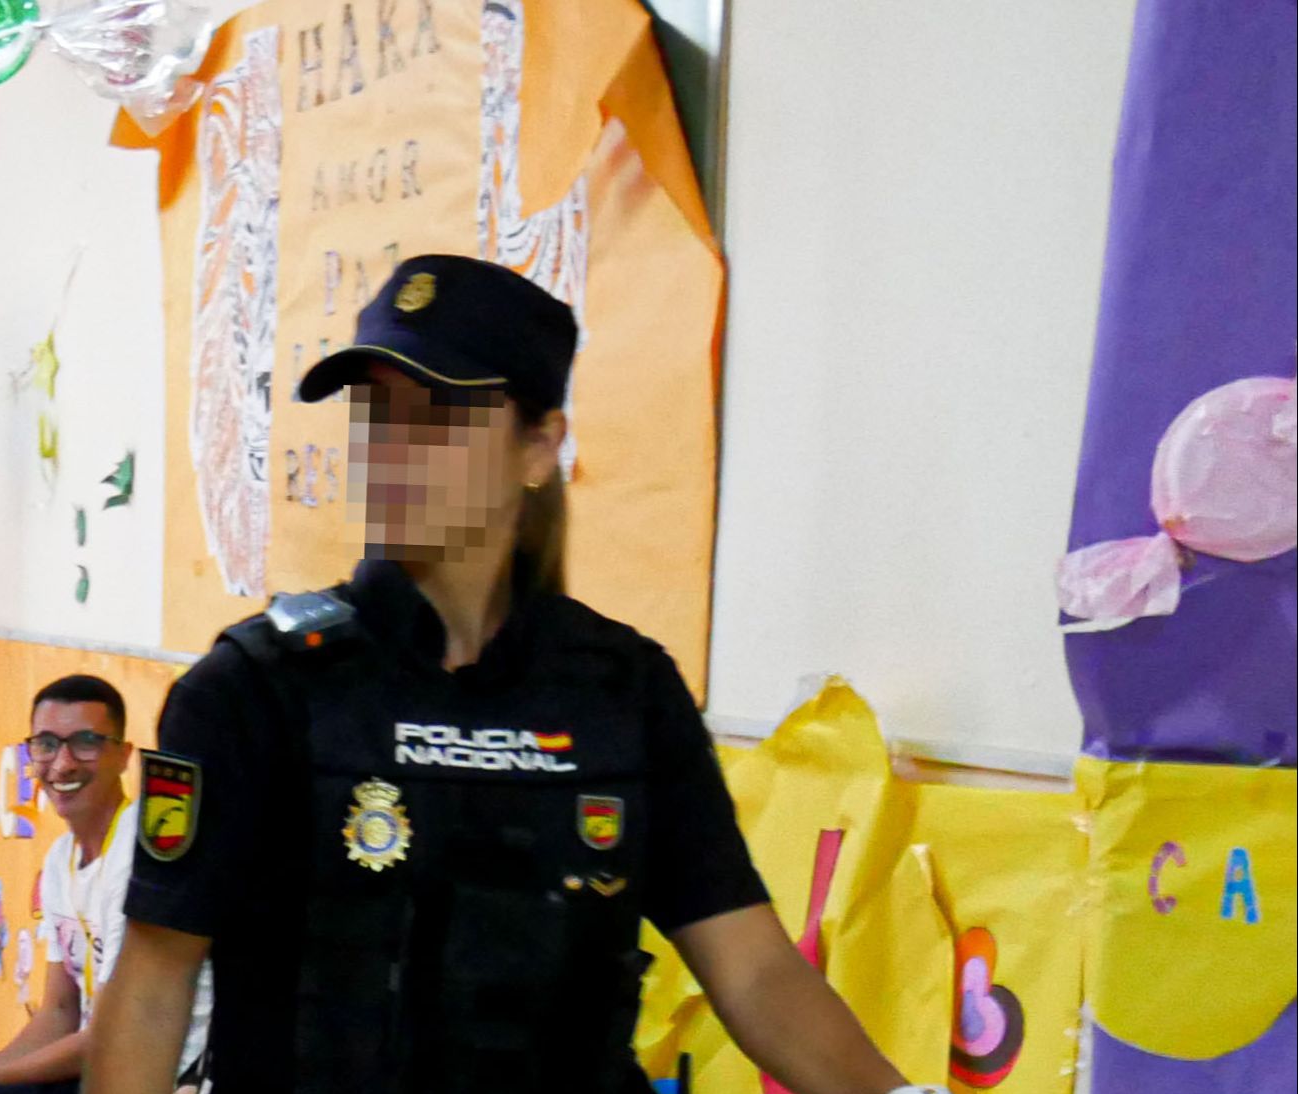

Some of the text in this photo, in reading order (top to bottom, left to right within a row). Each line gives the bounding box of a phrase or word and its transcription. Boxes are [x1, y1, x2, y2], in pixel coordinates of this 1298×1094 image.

[296, 0, 440, 112] HAKA
[312, 139, 423, 210] AMOR
[395, 722, 539, 750] POLICIA
[395, 744, 578, 772] NACIONAL
